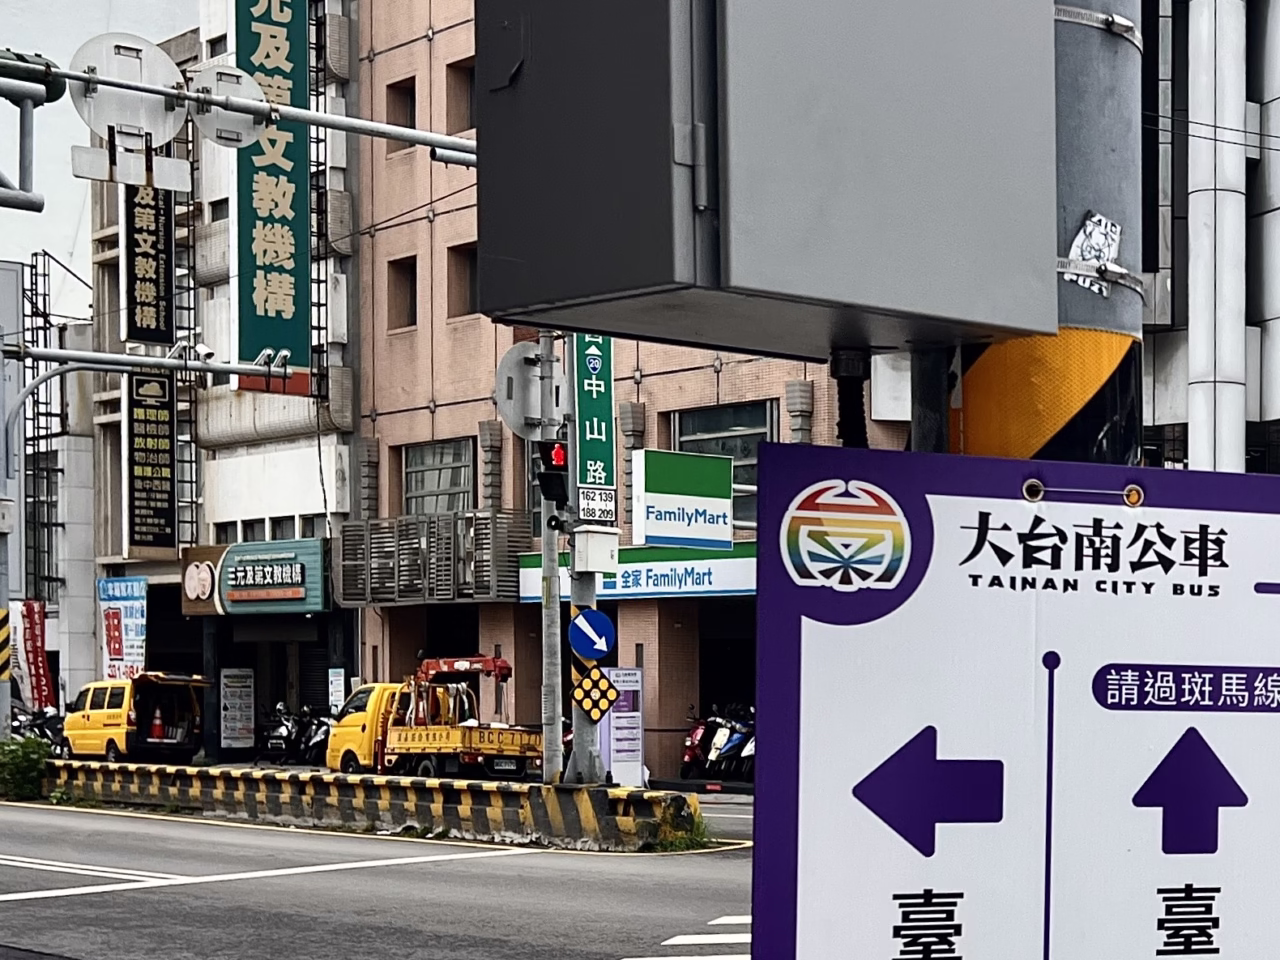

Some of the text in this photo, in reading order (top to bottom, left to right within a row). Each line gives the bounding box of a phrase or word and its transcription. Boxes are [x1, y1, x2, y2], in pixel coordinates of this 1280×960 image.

[584, 375, 607, 484] 中山路
[581, 490, 613, 502] 162 139
[581, 508, 613, 519] 188 209
[646, 505, 728, 527] FamilyMart
[958, 511, 1230, 577] 大台南公車
[621, 566, 713, 589] 全家 FamilyMart
[968, 573, 1222, 597] TAINAN CITY BUS
